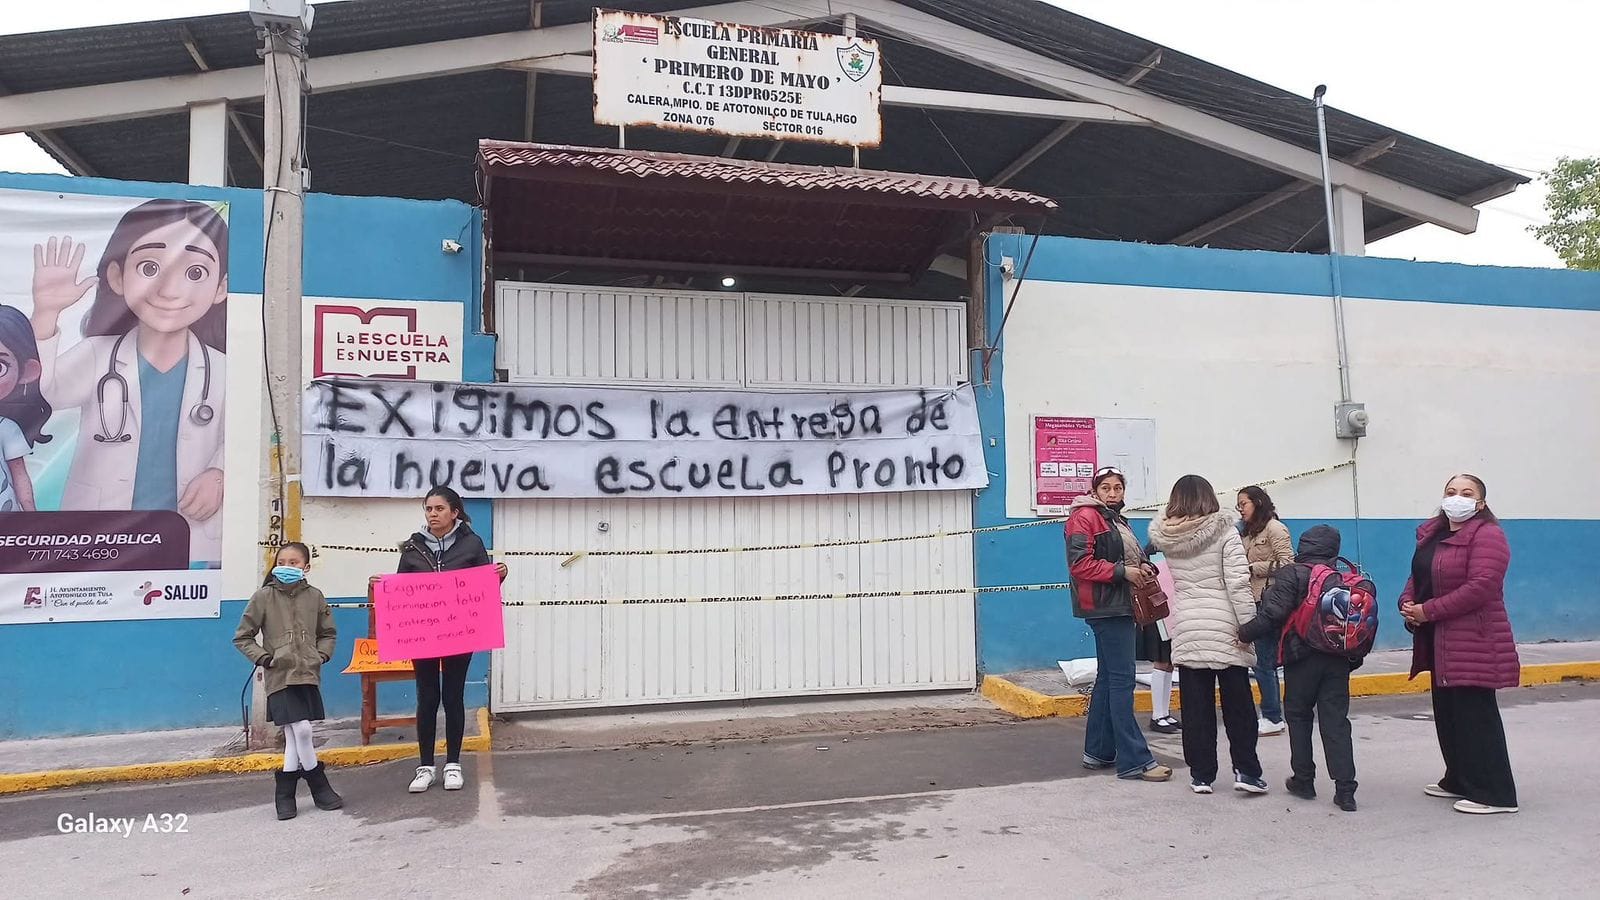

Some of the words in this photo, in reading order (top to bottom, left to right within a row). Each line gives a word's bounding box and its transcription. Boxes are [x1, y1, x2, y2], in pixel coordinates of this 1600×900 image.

[664, 19, 731, 41] ESCUELA
[737, 28, 818, 50] PRIMARIA
[707, 45, 779, 66] GENERAL
[655, 58, 743, 81] PRIMERO
[751, 68, 774, 84] DE
[781, 71, 829, 90] MAYO
[683, 81, 714, 96] C.C.T
[719, 85, 802, 104] 13DPR0525E
[663, 112, 693, 124] ZONA
[696, 116, 715, 126] 076
[763, 121, 803, 133] SECTOR
[805, 125, 823, 135] 016
[706, 101, 720, 112] DE
[723, 103, 787, 117] ATOTONILCO
[790, 109, 803, 119] DE
[806, 110, 857, 124] TULA,HGO
[650, 399, 699, 438] la
[713, 400, 882, 440] entrega
[906, 389, 949, 435] de
[326, 440, 367, 490] la
[0, 534, 91, 546] SEGURIDAD
[94, 533, 162, 545] PUBLICA
[28, 550, 50, 560] 771
[54, 549, 79, 560] 743
[82, 548, 119, 560] 4690
[164, 584, 208, 600] SALUD
